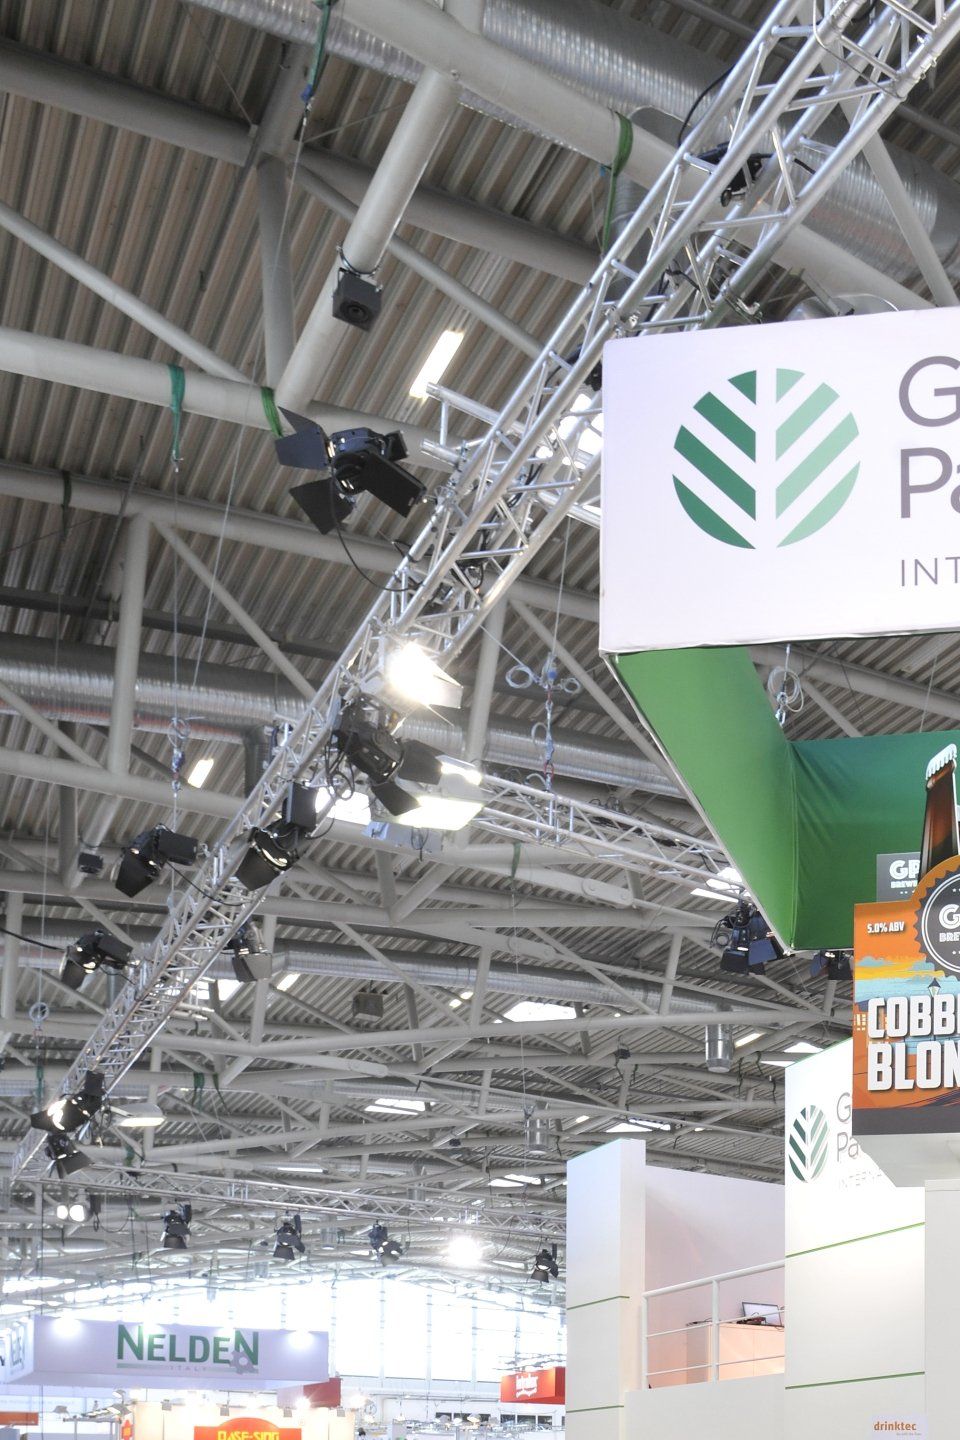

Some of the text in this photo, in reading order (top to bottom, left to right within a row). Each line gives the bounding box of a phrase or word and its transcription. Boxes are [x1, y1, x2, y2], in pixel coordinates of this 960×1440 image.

[889, 859, 920, 880] GP
[867, 922, 905, 934] 5.0% ABV
[116, 1324, 259, 1366] NELDEN
[873, 1420, 917, 1431] drinktec
